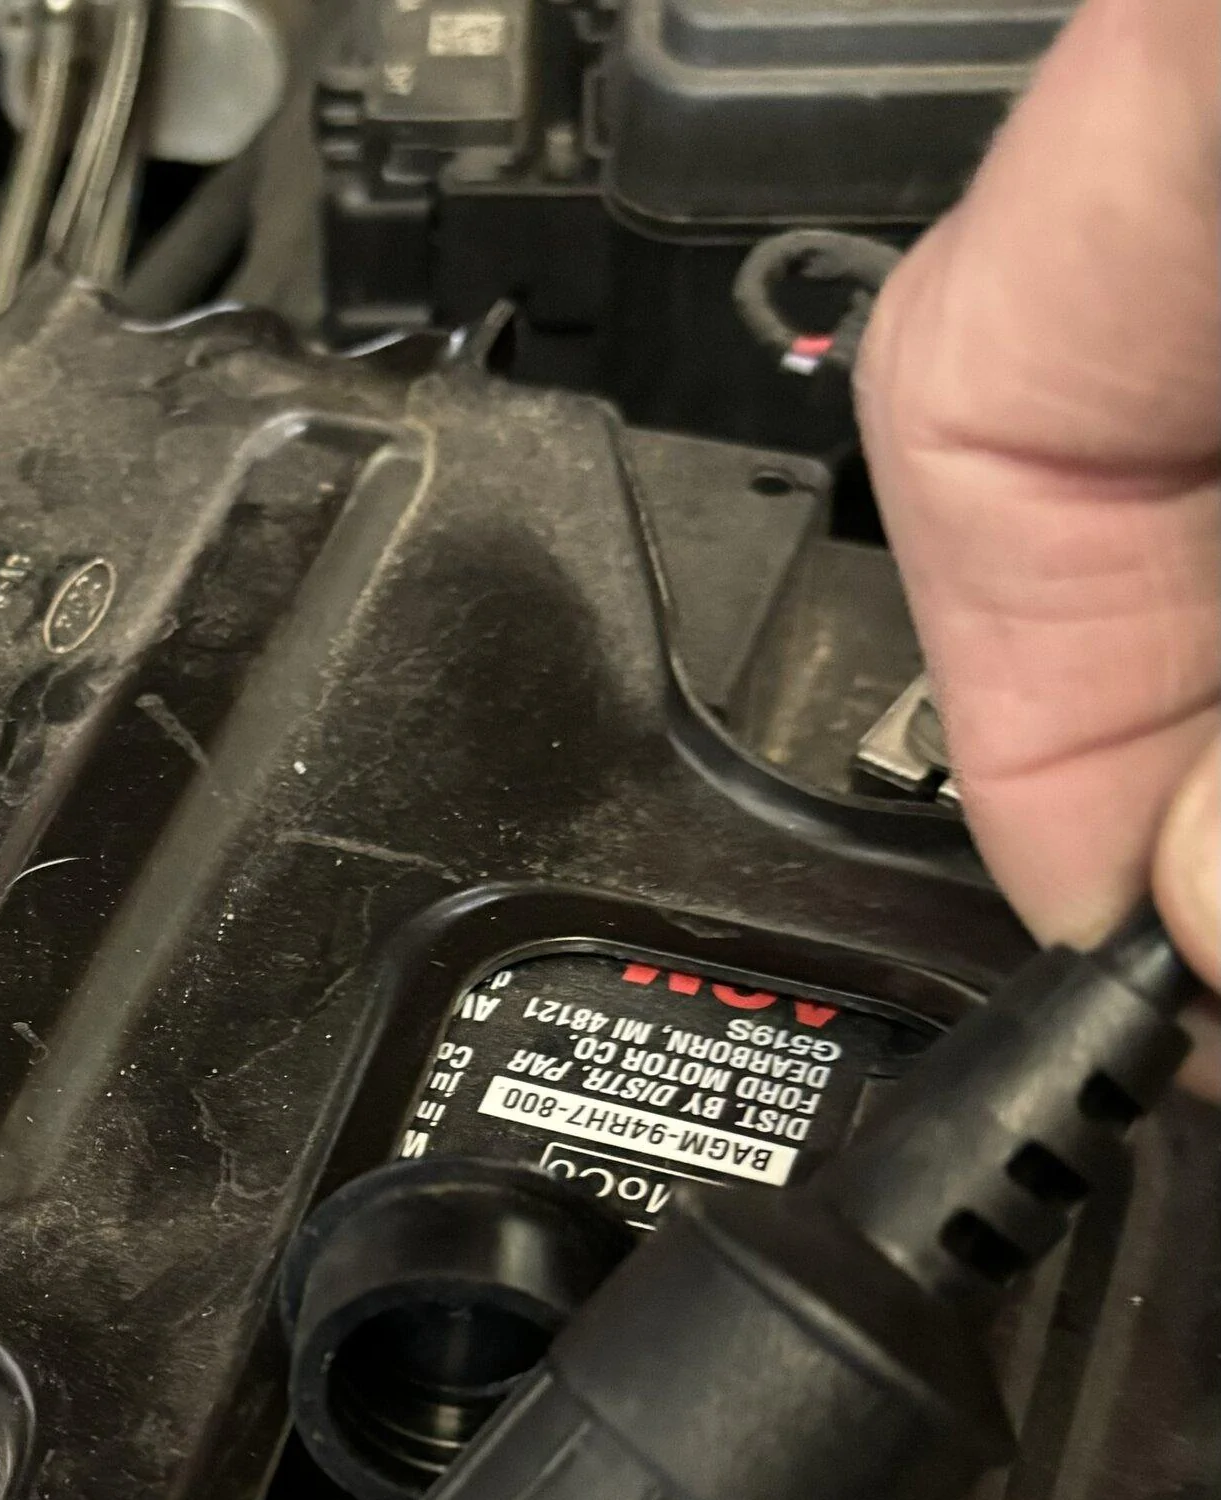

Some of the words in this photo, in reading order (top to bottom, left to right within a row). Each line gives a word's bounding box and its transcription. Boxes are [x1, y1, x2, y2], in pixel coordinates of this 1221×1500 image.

[523, 997, 610, 1033] 48121
[611, 1017, 654, 1045] MI
[569, 1034, 618, 1065] CO.
[662, 1023, 831, 1090] DEARBORN,
[726, 1018, 842, 1062] G519S
[507, 1049, 574, 1081] PAR
[621, 1047, 733, 1093] MOTOR
[581, 1065, 679, 1107] DISTR.
[736, 1076, 822, 1114] FORD
[679, 1091, 728, 1120] BY
[734, 1103, 812, 1141] DIST.
[502, 1087, 774, 1172] BAGM-94RH7-800
